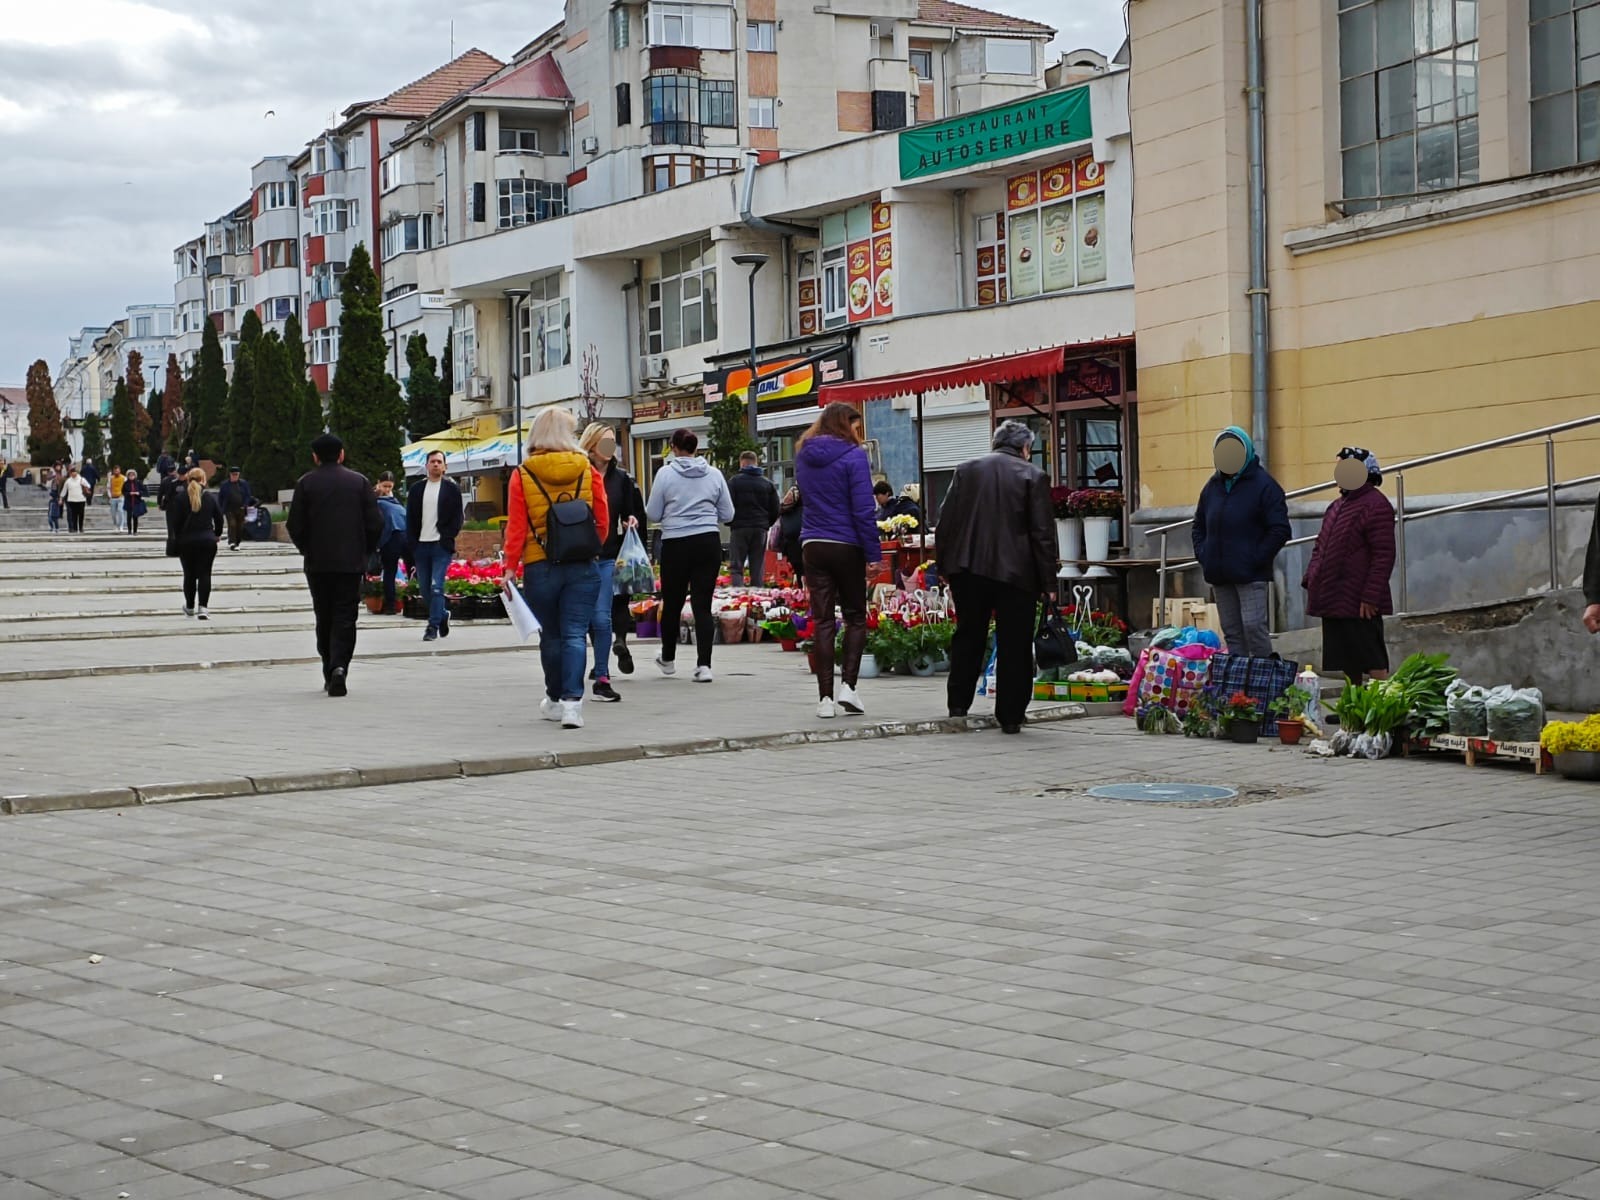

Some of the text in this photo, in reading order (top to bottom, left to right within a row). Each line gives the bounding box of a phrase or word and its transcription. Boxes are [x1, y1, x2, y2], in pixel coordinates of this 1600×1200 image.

[935, 104, 1048, 143] RESTAURANT
[919, 120, 1070, 169] AUTOSERVIRE
[1500, 742, 1534, 757] Extra Berry
